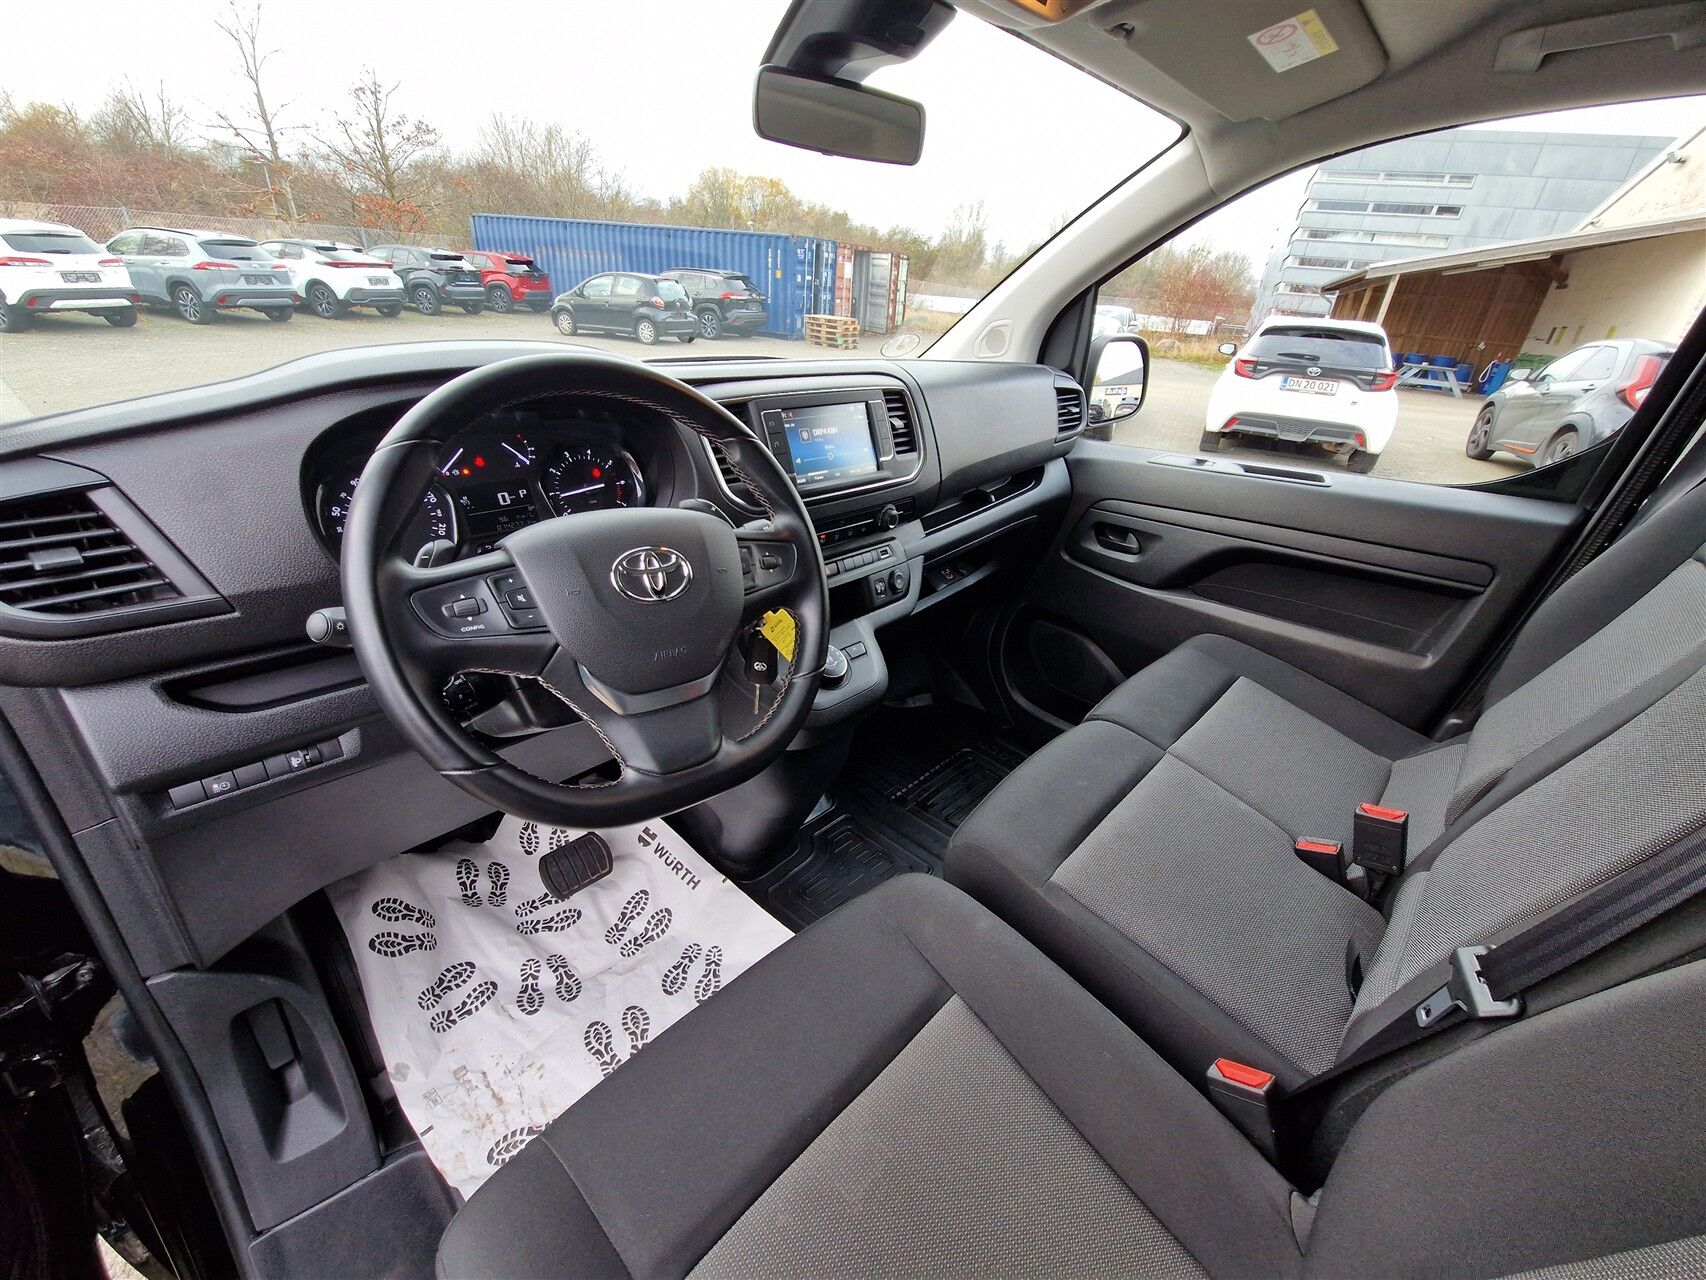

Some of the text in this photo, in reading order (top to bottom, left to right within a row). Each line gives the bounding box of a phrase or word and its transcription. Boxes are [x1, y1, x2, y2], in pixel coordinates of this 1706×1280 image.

[1288, 379, 1302, 388] DN
[1304, 381, 1316, 390] 20
[1318, 382, 1335, 391] 021
[518, 489, 527, 498] P
[331, 506, 341, 517] 50
[438, 523, 446, 536] 210
[460, 624, 485, 633] CONFIG
[654, 646, 688, 661] AIRBAG
[653, 842, 702, 891] WÜRTH
